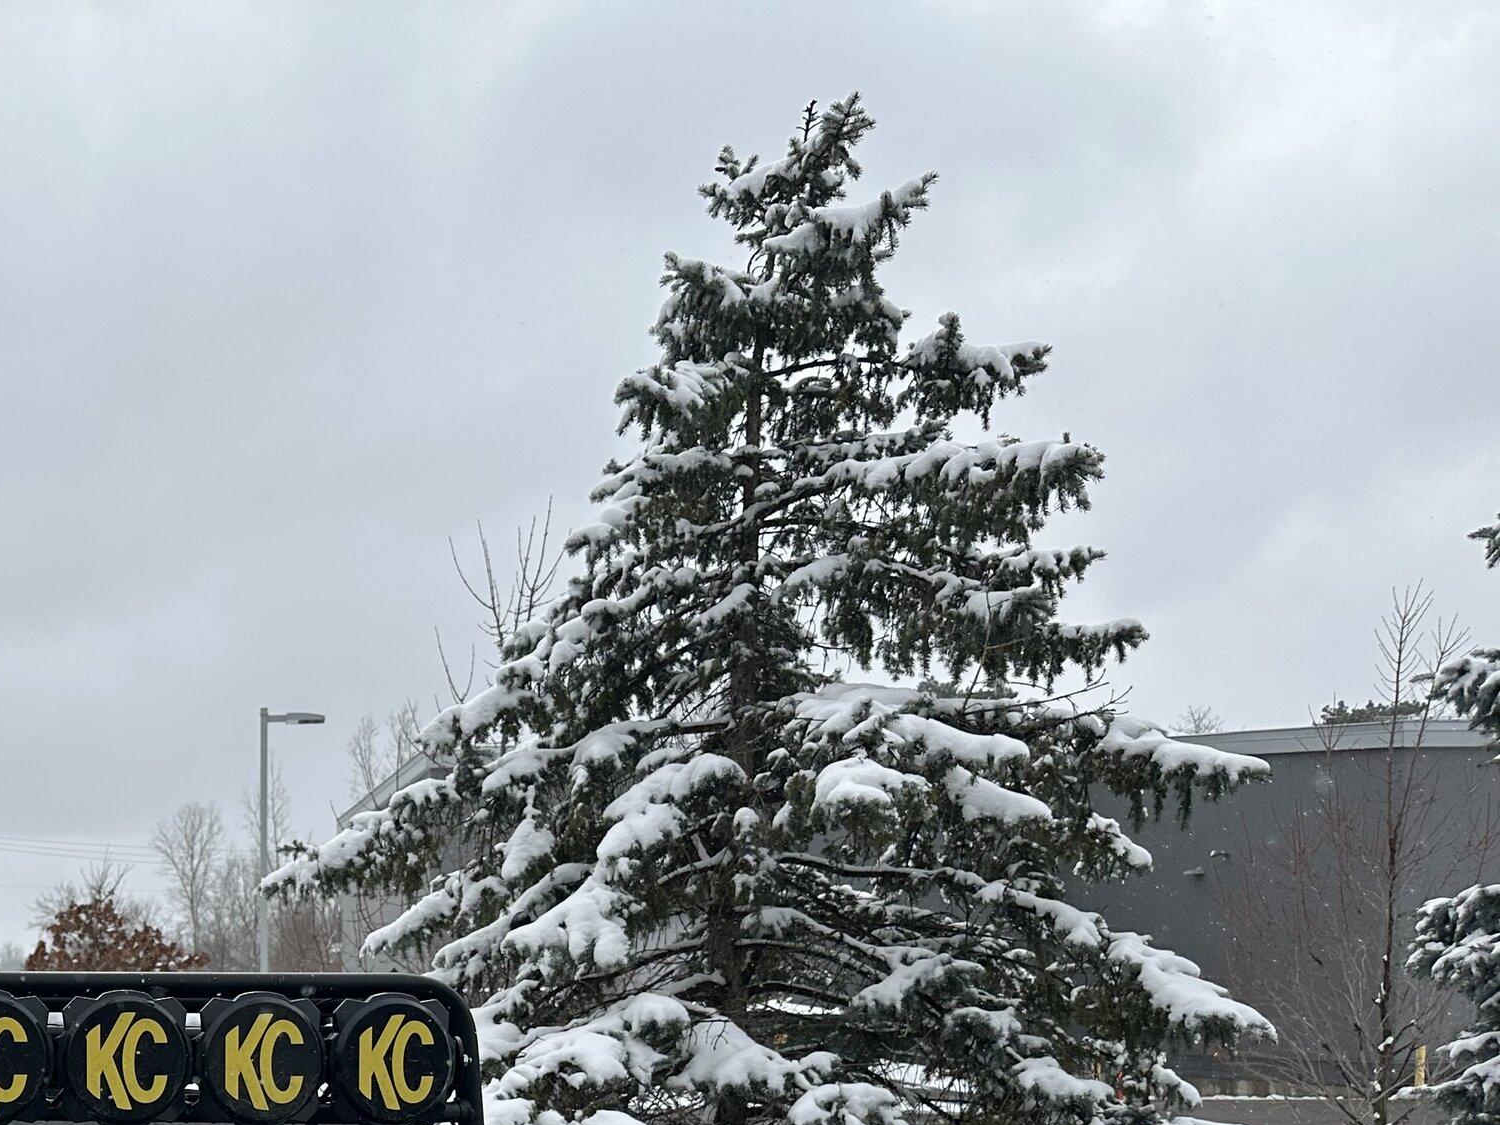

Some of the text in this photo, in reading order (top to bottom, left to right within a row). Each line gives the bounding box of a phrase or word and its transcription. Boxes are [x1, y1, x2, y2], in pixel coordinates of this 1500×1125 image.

[86, 1011, 168, 1110] KC
[224, 1013, 304, 1111] KC
[358, 1014, 435, 1111] KC
